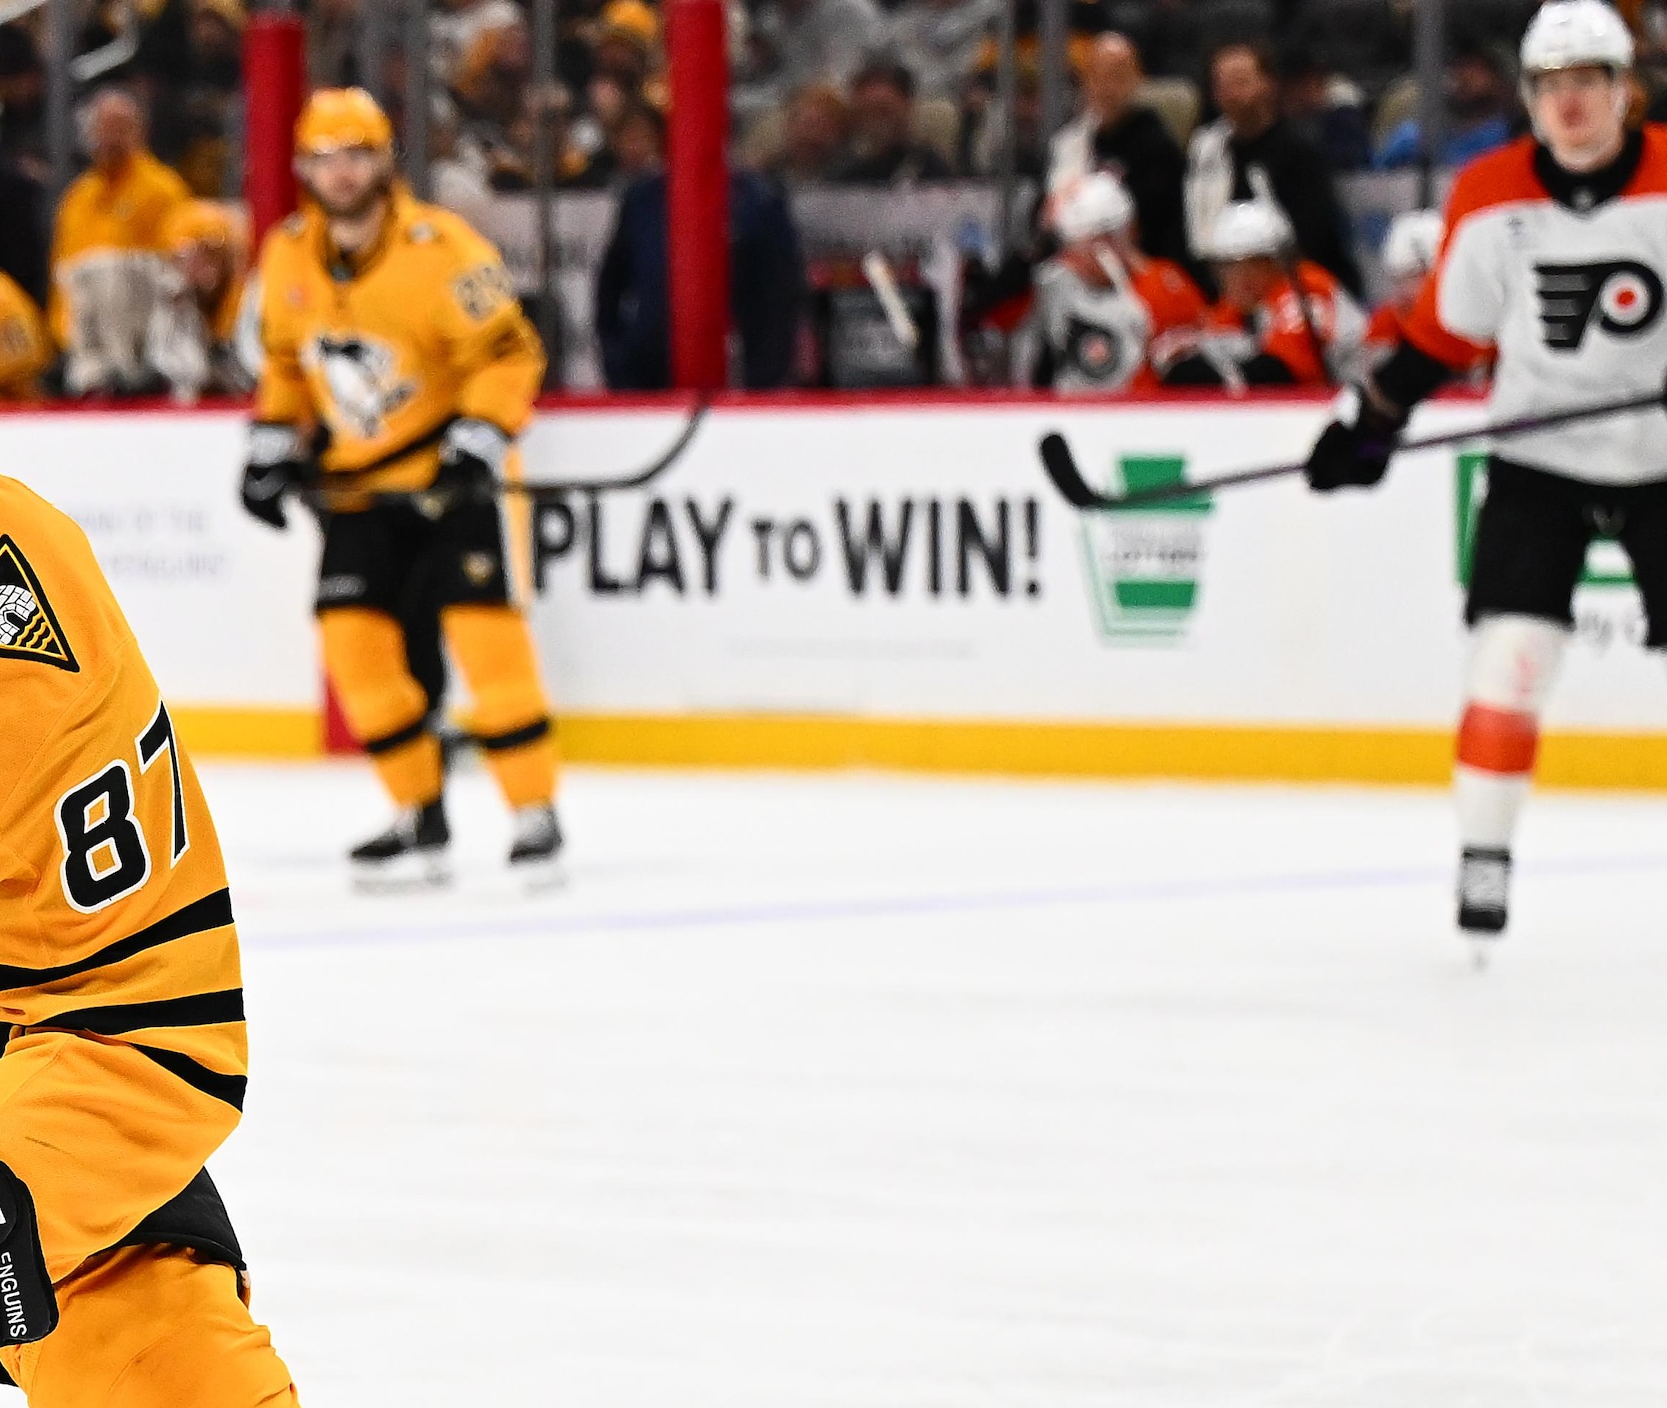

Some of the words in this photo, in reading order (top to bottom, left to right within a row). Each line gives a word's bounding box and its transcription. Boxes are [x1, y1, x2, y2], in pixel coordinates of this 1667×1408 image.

[532, 497, 733, 597] PLAY
[834, 496, 1041, 598] WIN!
[54, 696, 191, 915] 87
